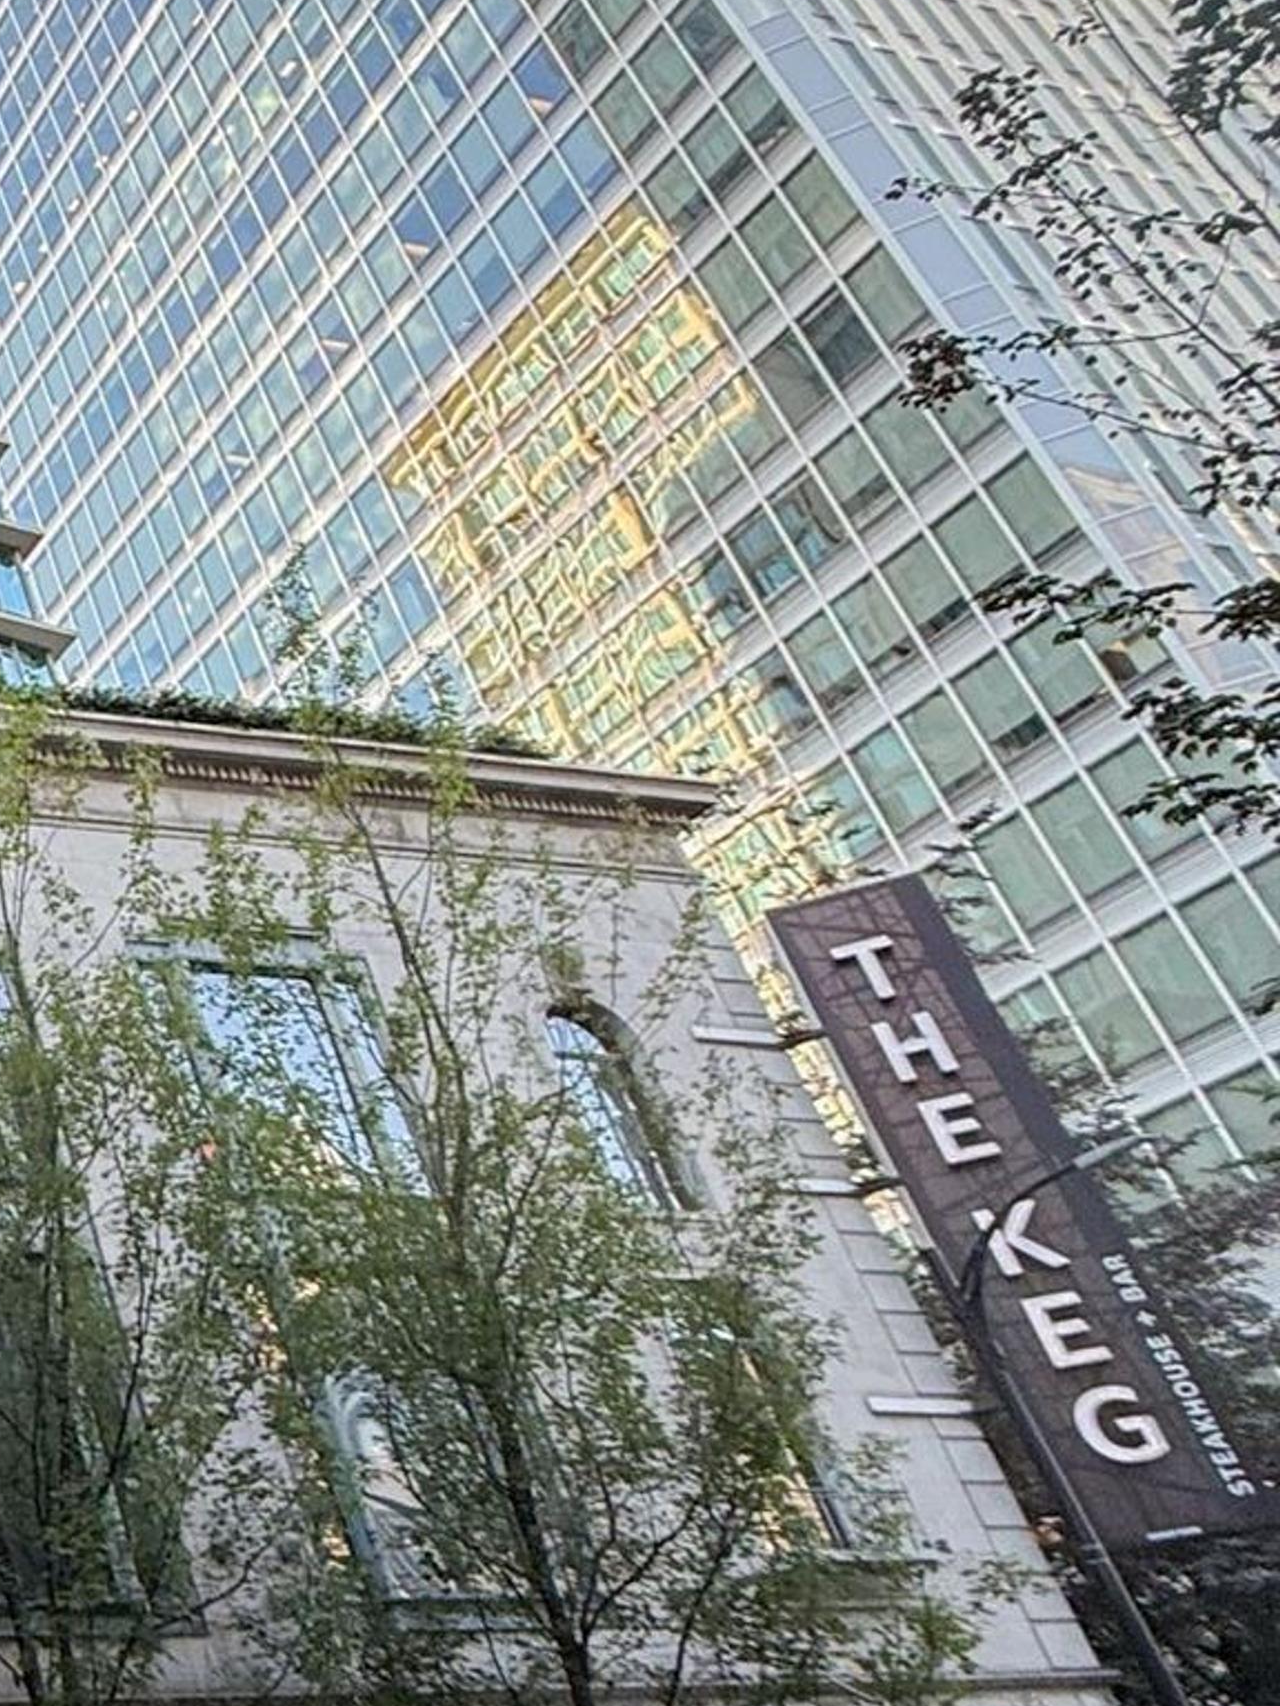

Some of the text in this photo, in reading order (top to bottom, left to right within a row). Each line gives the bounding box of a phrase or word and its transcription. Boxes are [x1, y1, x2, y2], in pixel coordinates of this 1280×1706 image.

[830, 934, 1171, 1464] THE KEG
[1102, 1252, 1147, 1303] BAR
[1145, 1332, 1256, 1497] STEAKHOUSE
